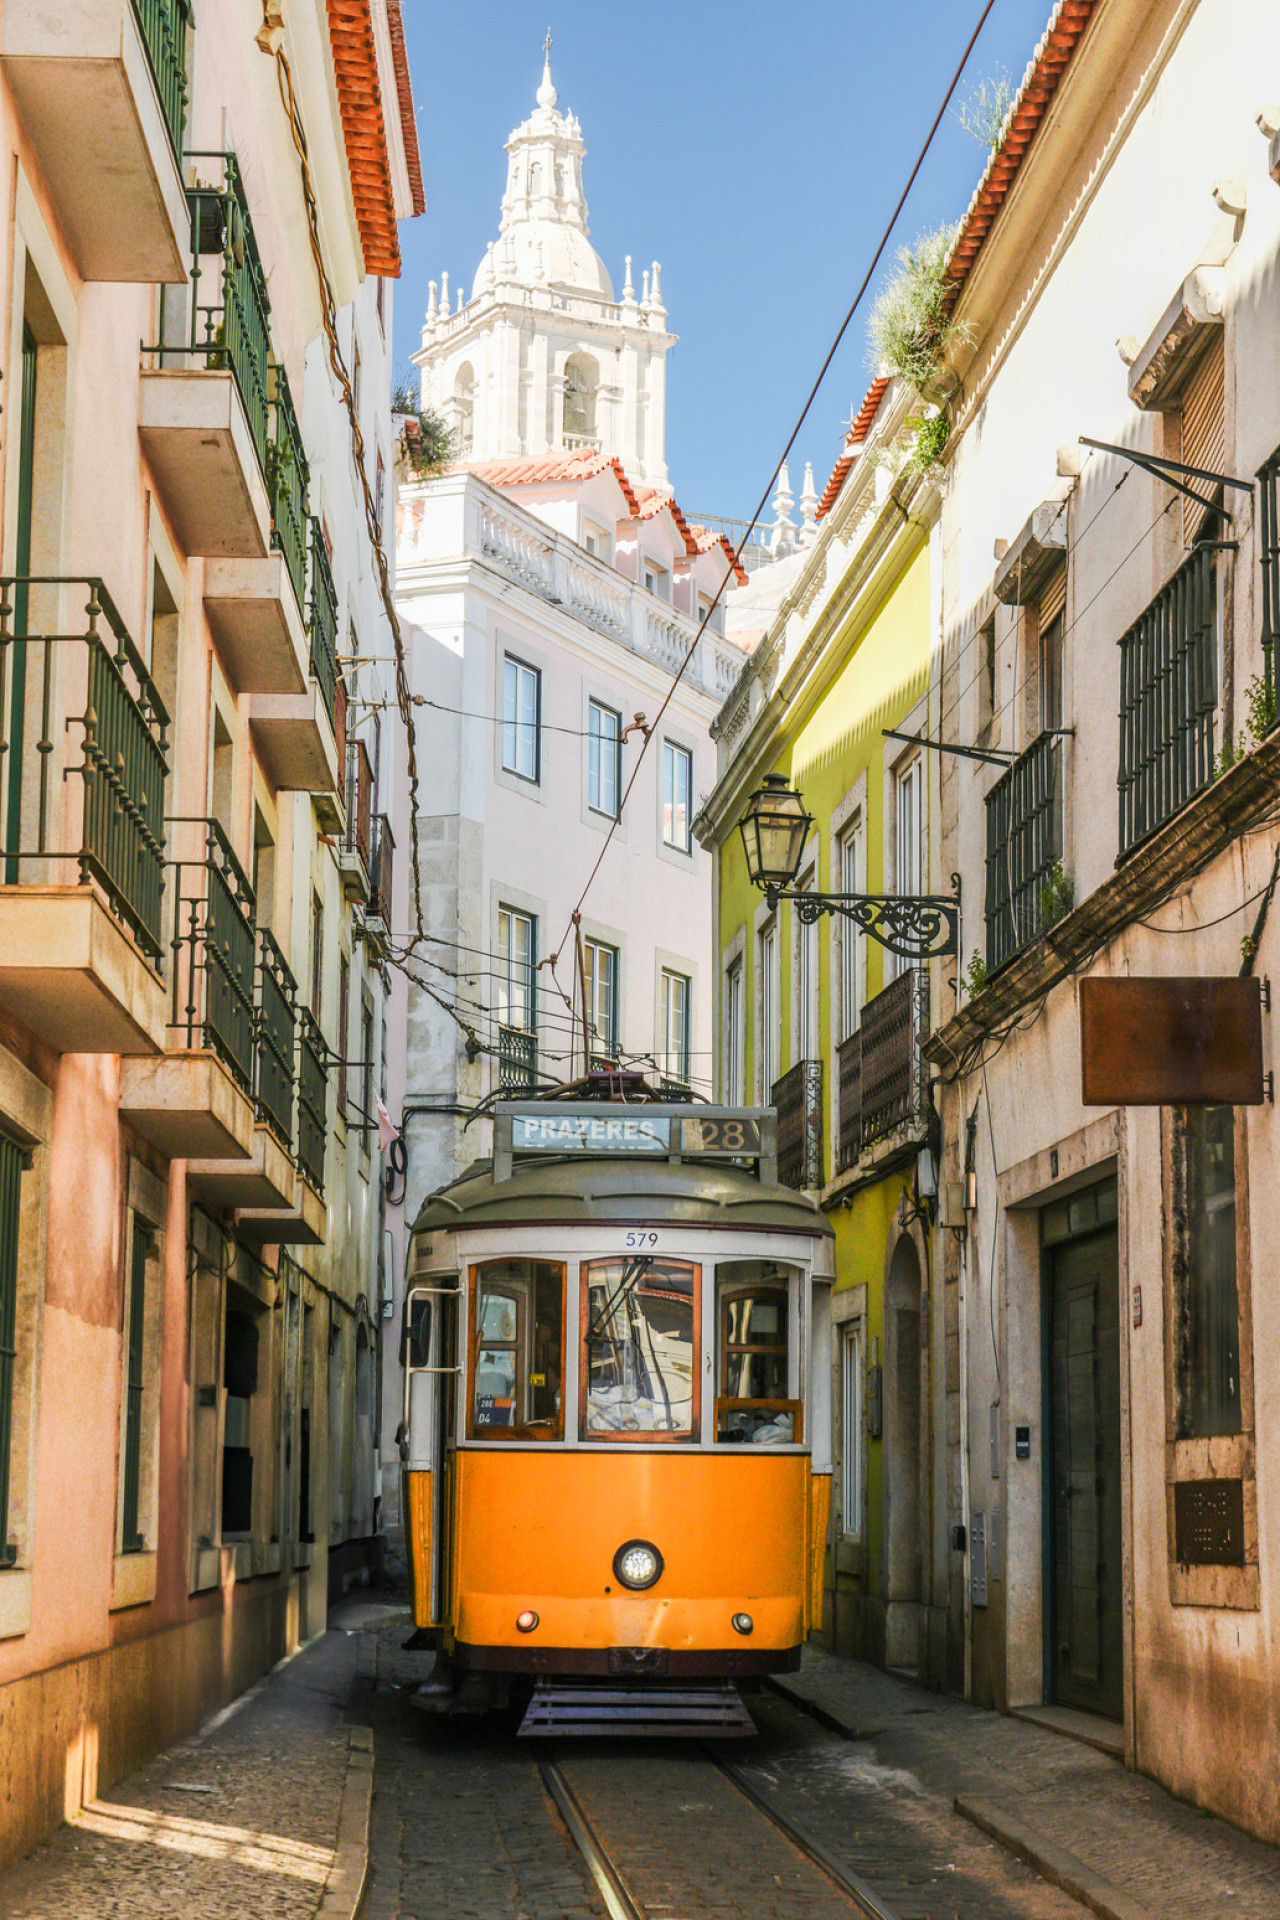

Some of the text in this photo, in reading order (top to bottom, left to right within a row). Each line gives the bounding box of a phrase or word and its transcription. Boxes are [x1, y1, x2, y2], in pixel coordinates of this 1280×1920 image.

[524, 1118, 654, 1141] PRAZERES
[701, 1120, 745, 1150] 28
[625, 1232, 658, 1247] 579
